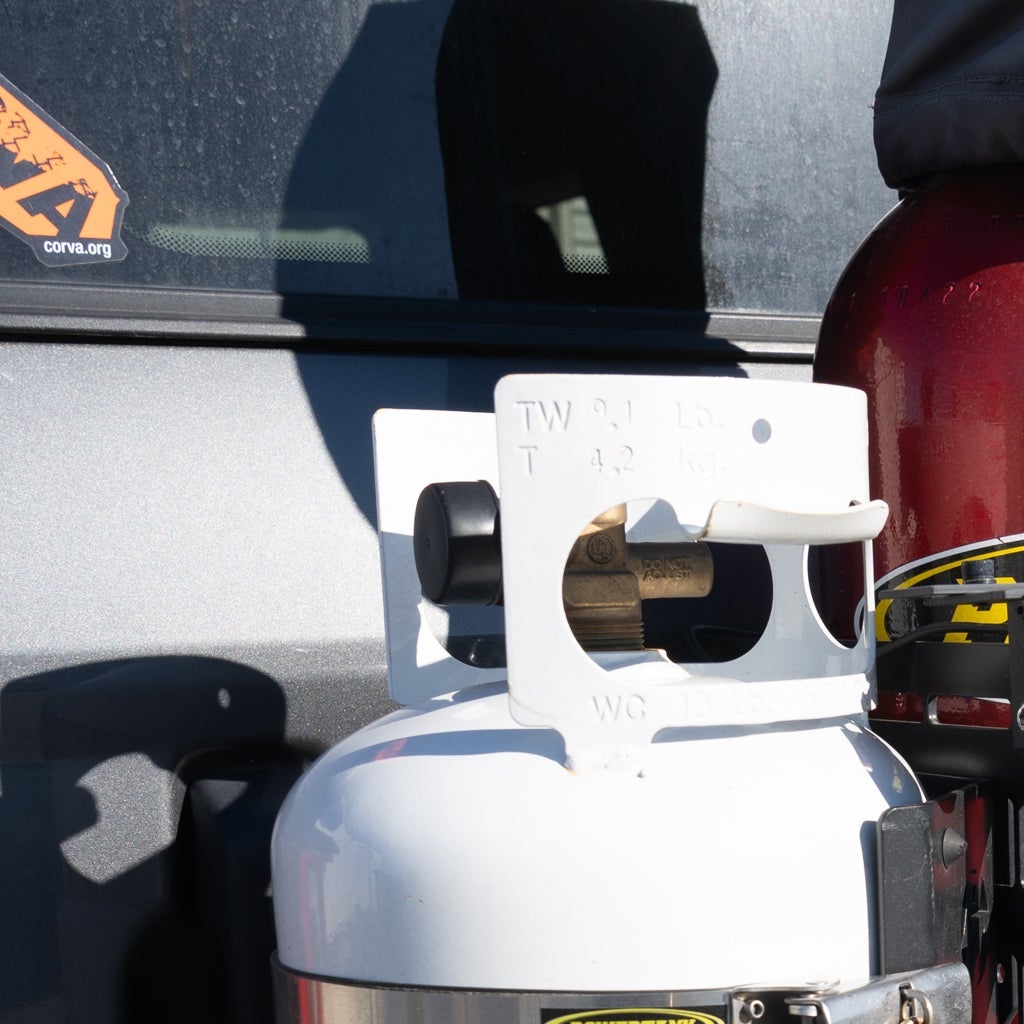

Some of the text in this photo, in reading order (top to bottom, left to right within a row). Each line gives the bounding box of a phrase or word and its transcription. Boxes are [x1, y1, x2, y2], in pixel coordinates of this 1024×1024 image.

[43, 240, 112, 258] corva.org
[515, 400, 572, 432] TW
[517, 444, 539, 476] T
[590, 444, 636, 477] 4.2
